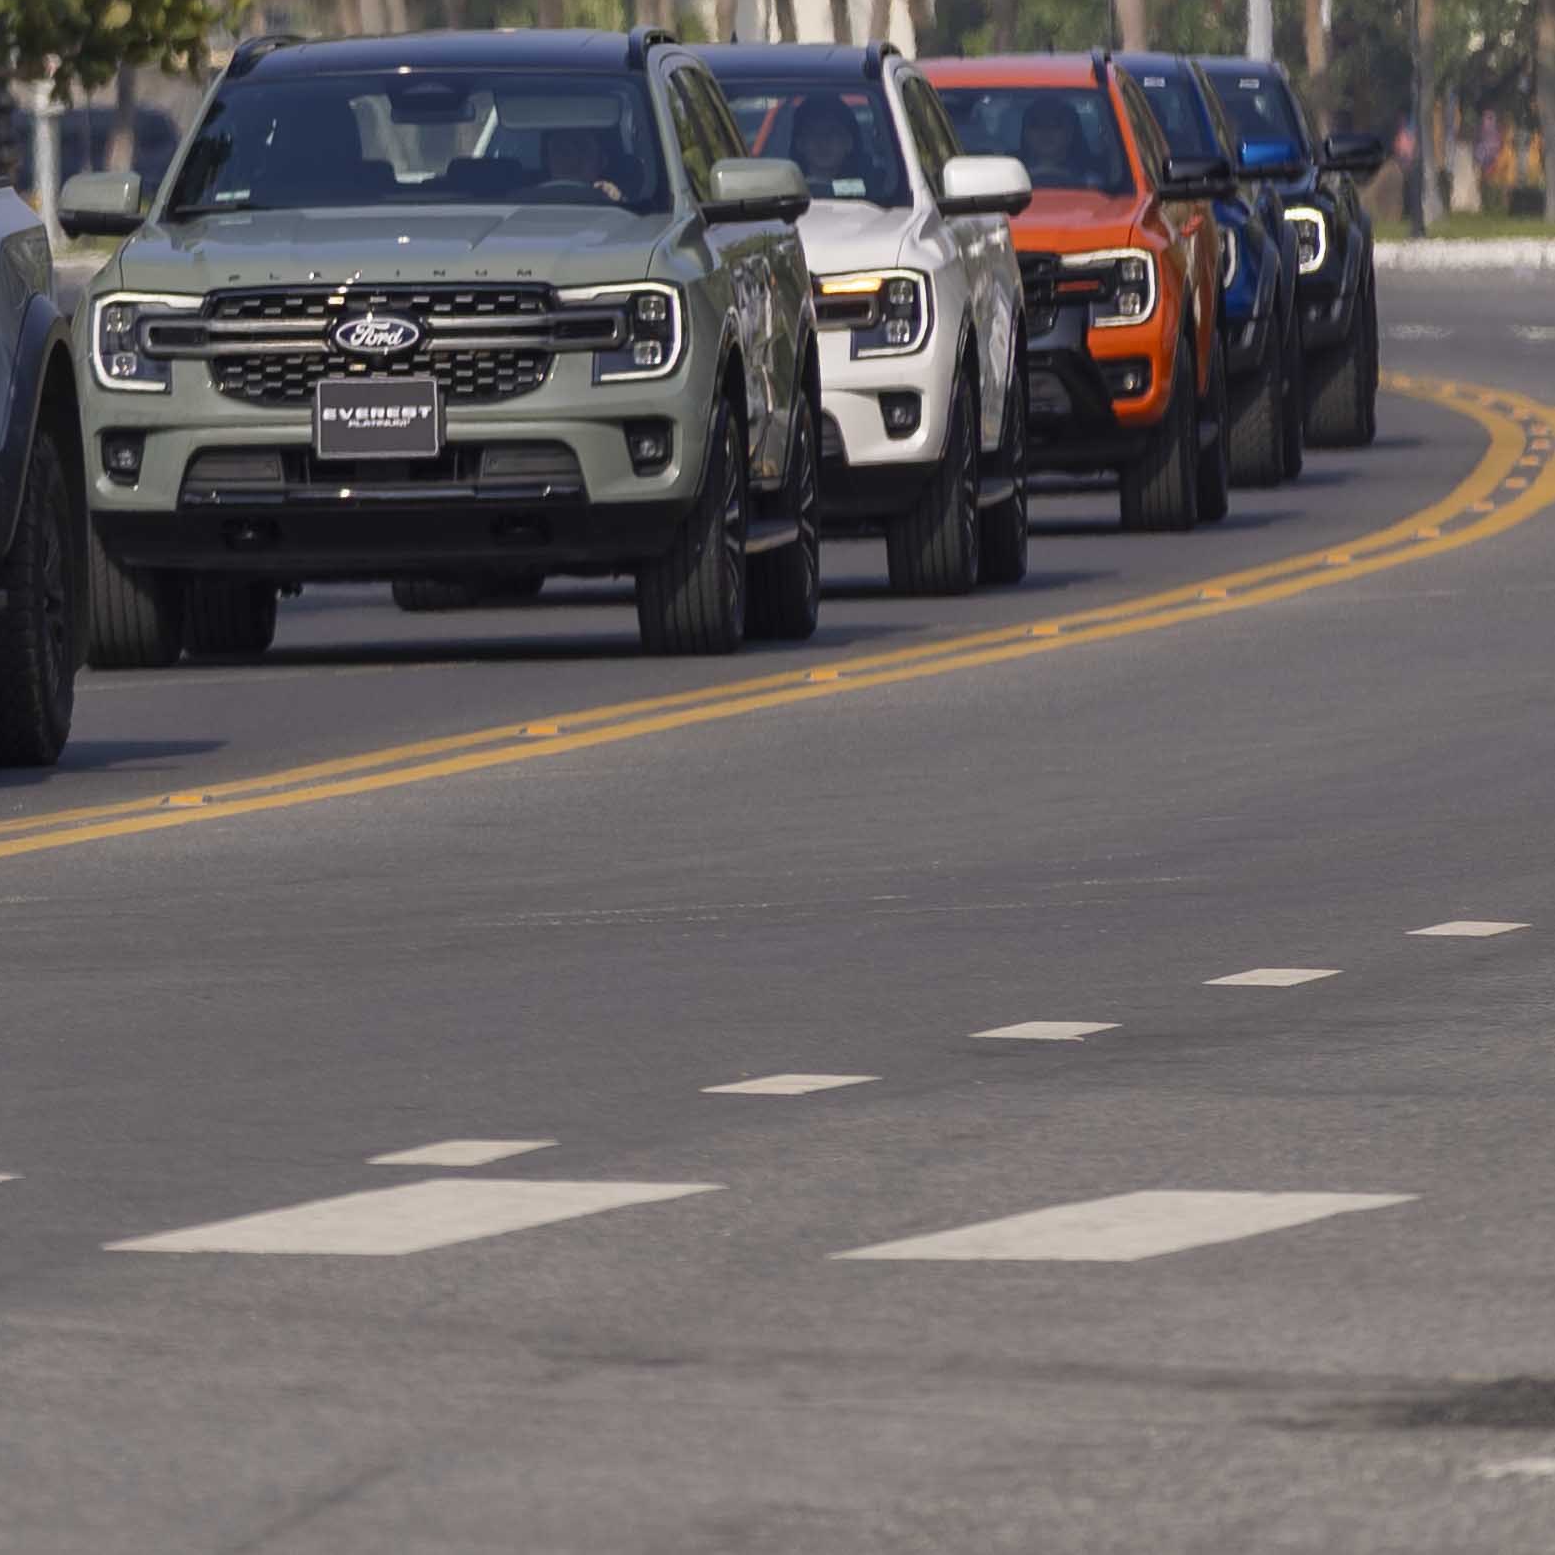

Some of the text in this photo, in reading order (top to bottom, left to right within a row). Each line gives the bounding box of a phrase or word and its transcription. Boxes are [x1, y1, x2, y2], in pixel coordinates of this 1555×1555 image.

[228, 268, 533, 282] PLAINUM
[350, 322, 403, 346] Ford
[322, 406, 432, 421] EVEREST
